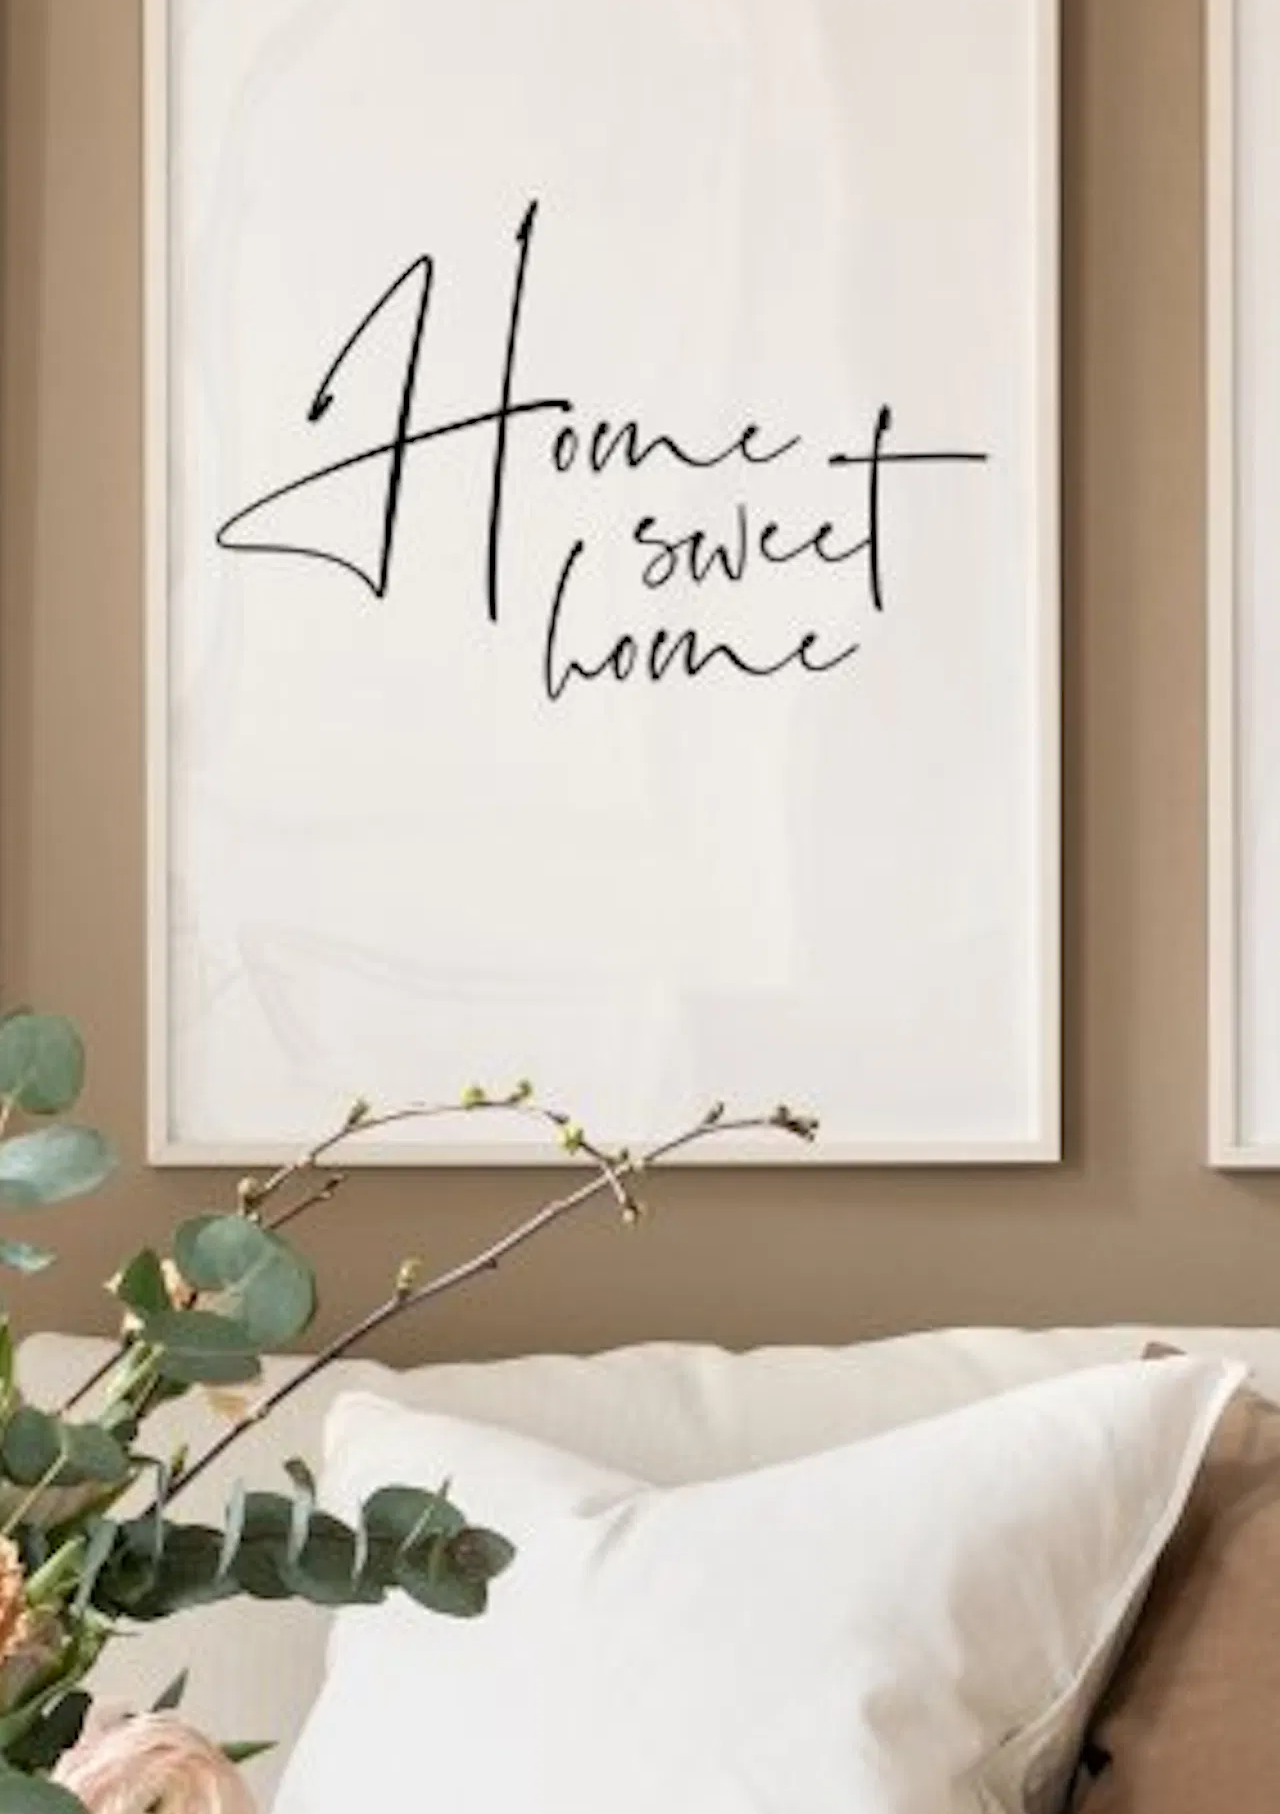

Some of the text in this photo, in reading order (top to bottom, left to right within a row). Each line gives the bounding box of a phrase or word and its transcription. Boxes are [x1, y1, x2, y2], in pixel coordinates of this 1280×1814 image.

[216, 199, 802, 623] Home
[633, 404, 988, 613] sweet
[544, 539, 859, 701] home
